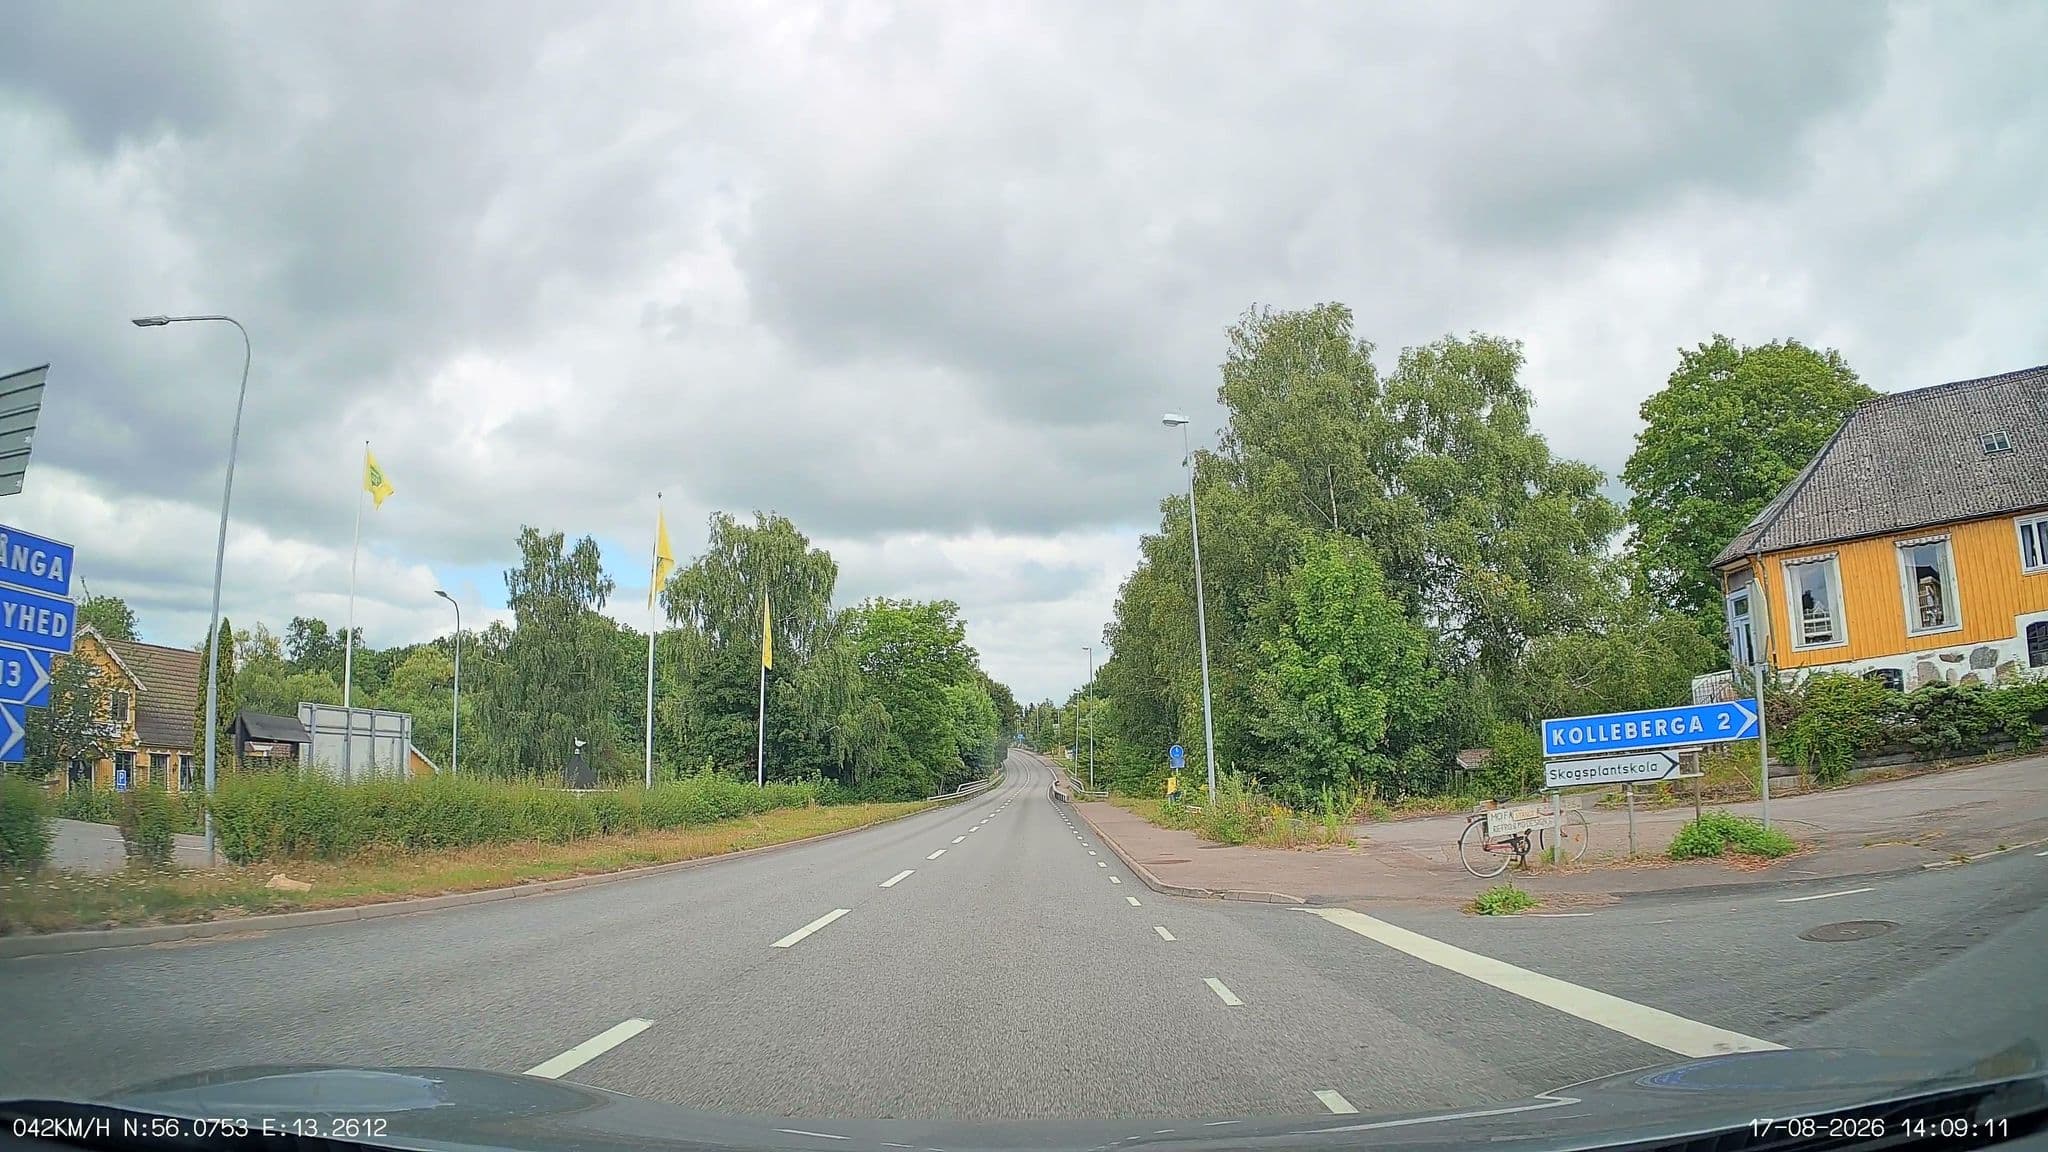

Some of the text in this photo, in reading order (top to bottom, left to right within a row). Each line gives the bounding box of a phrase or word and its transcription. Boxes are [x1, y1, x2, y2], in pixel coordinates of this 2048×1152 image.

[2, 601, 68, 638] YHED
[1552, 712, 1732, 746] KOLLEBERGA 2
[1549, 761, 1658, 781] Skogsplantskola
